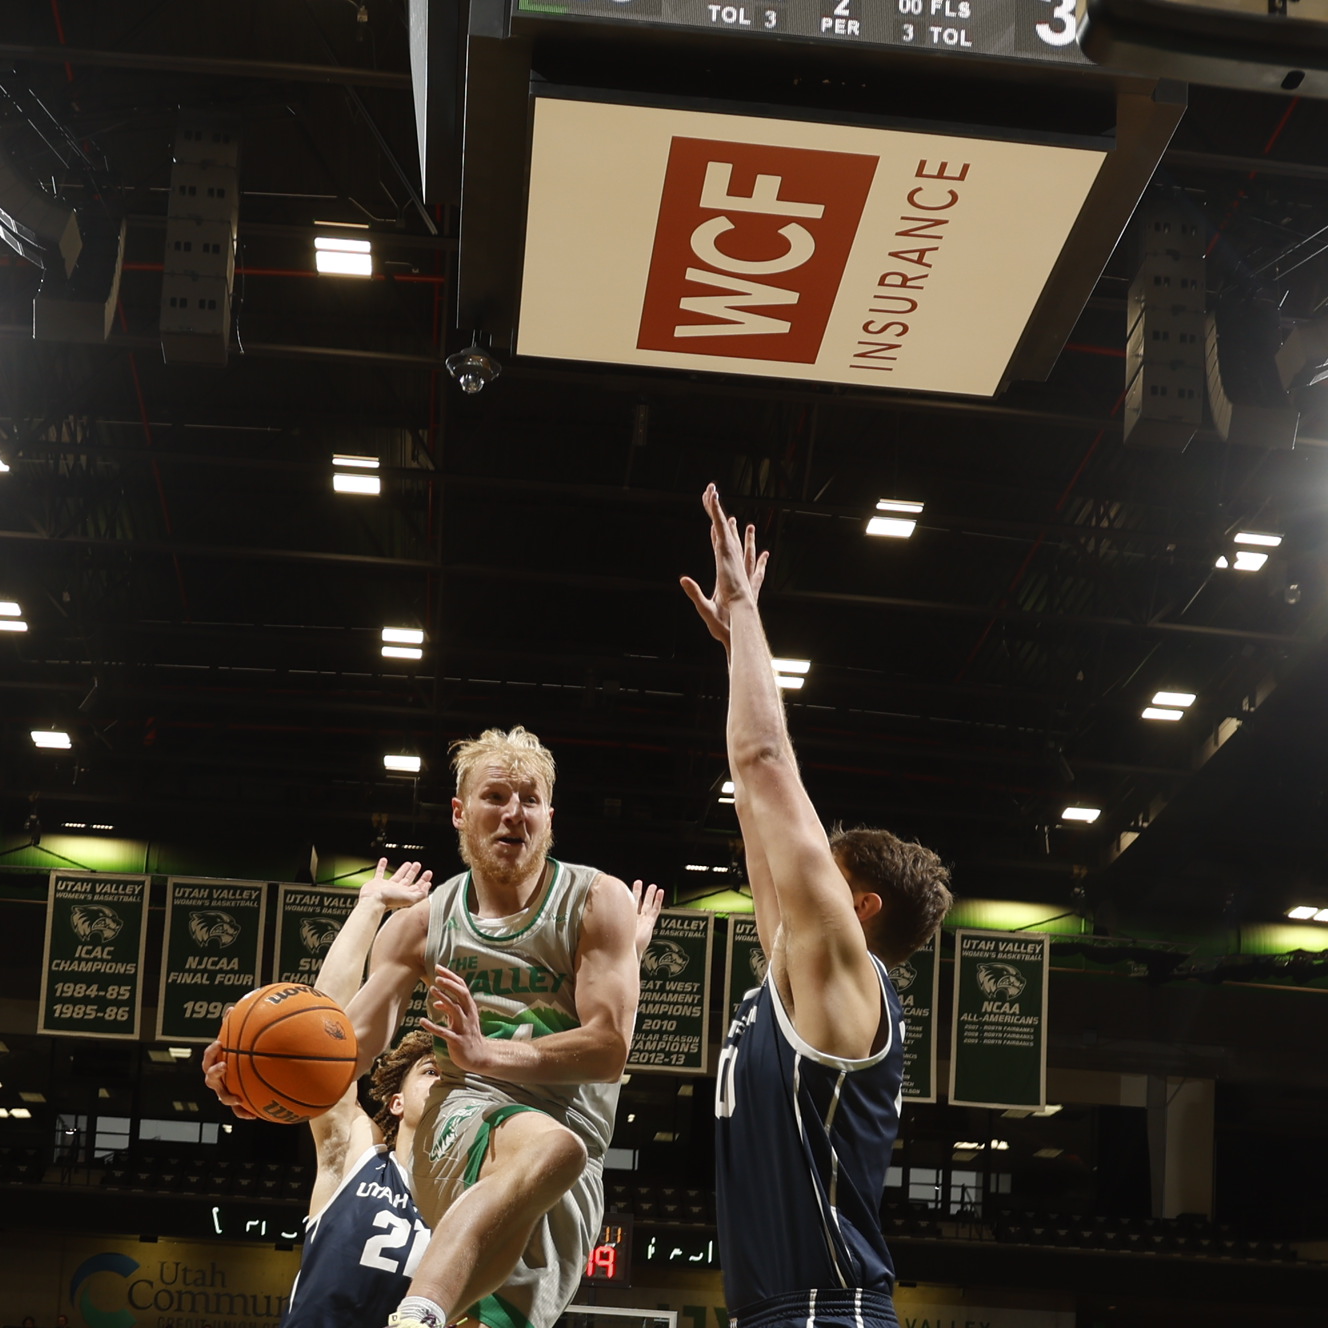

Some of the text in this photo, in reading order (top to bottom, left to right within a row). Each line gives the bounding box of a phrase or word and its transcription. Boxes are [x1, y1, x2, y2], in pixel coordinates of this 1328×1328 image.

[931, 0, 970, 18] FLS
[708, 5, 972, 47] TOL 3 PER 3 TOL
[674, 161, 825, 337] WCF
[850, 159, 970, 371] INSURANCE
[56, 881, 143, 894] UTAH VALLEY
[175, 888, 259, 900] UTAH VALLEY
[55, 892, 141, 902] WOMEN'S BASKETBALL
[174, 898, 259, 907] WOMEN'S BASKETBALL
[286, 894, 319, 904] UTAH
[285, 905, 321, 913] WOMEN'S
[661, 919, 707, 930] VALLEY
[660, 930, 706, 938] BASKETBALL
[75, 945, 114, 959] ICAC
[963, 939, 1043, 953] UTAH VALLEY
[185, 956, 239, 970] NJCAA
[997, 952, 1042, 961] BASKETBALL
[51, 960, 136, 974] CHAMPIONS
[168, 972, 254, 986] FINAL FOUR
[54, 983, 131, 1000] 1984-85
[666, 981, 700, 992] WEST
[53, 1003, 130, 1021] 1985-86
[982, 1001, 1021, 1014] NCAA
[642, 1019, 677, 1031] 2010
[960, 1013, 1039, 1024] ALL-AMERICANS
[629, 1053, 686, 1065] 2012-13
[356, 1182, 409, 1209] UTAH
[586, 1246, 617, 1278] 19
[159, 1260, 226, 1288] Utah
